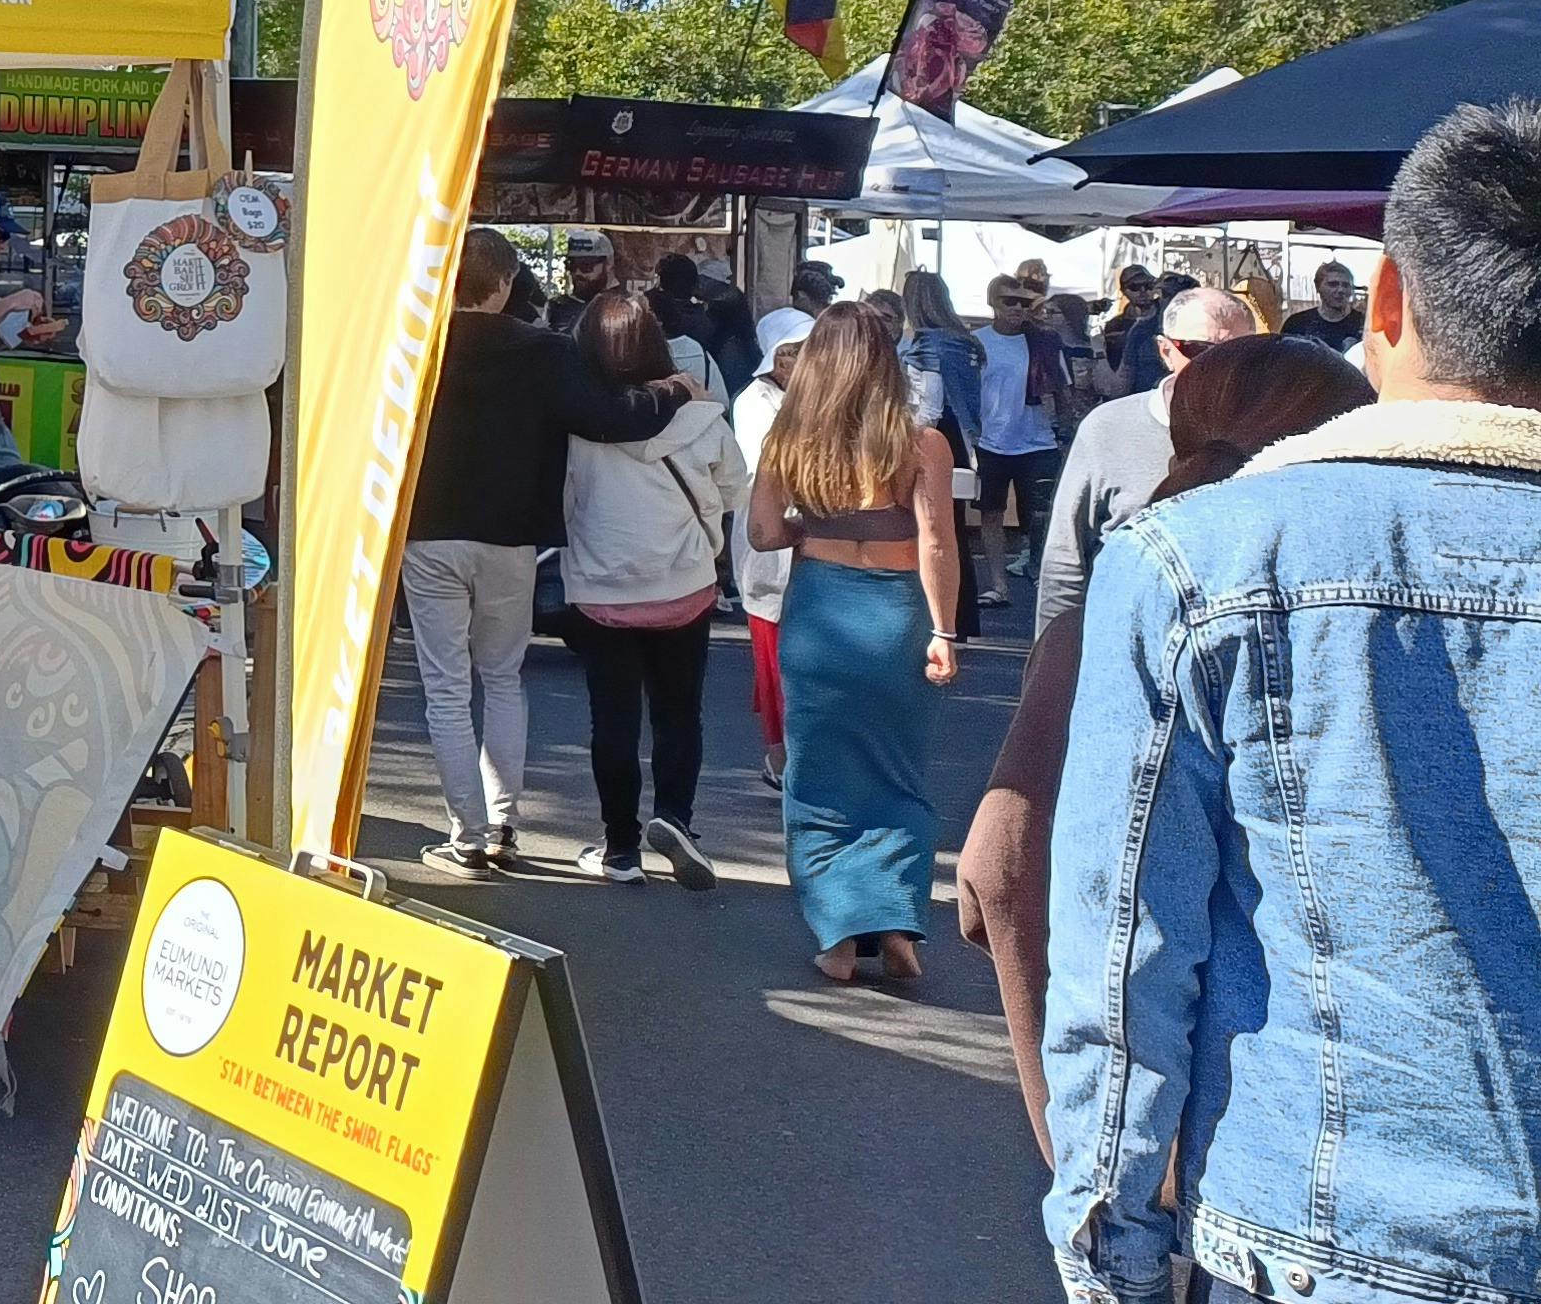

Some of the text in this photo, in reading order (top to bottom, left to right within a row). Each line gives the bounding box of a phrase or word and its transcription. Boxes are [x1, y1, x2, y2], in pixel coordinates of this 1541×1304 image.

[6, 72, 79, 91] HANDMADE
[83, 77, 120, 94] PORK
[122, 79, 150, 96] AND
[0, 92, 155, 140] DUMPLIN
[581, 150, 845, 191] GERMAN SAUSAGE HUT
[183, 916, 220, 940] ORIGINAL
[152, 961, 223, 1006] MARKETS
[159, 939, 229, 983] EUMUNDI
[292, 928, 444, 1036] MARKET
[275, 1004, 421, 1112] REPORT
[253, 1073, 314, 1121] BETWEEN
[317, 1101, 343, 1134] THE
[342, 1115, 382, 1154] SWIRL
[110, 1091, 179, 1154] WELCOME
[184, 1126, 210, 1169] TO:
[218, 1138, 246, 1186] The
[245, 1158, 309, 1216] Original
[304, 1188, 361, 1243] Eumundi
[90, 1170, 183, 1248] CONDITIONS:
[100, 1129, 328, 1280] DATE: WED 21ST June
